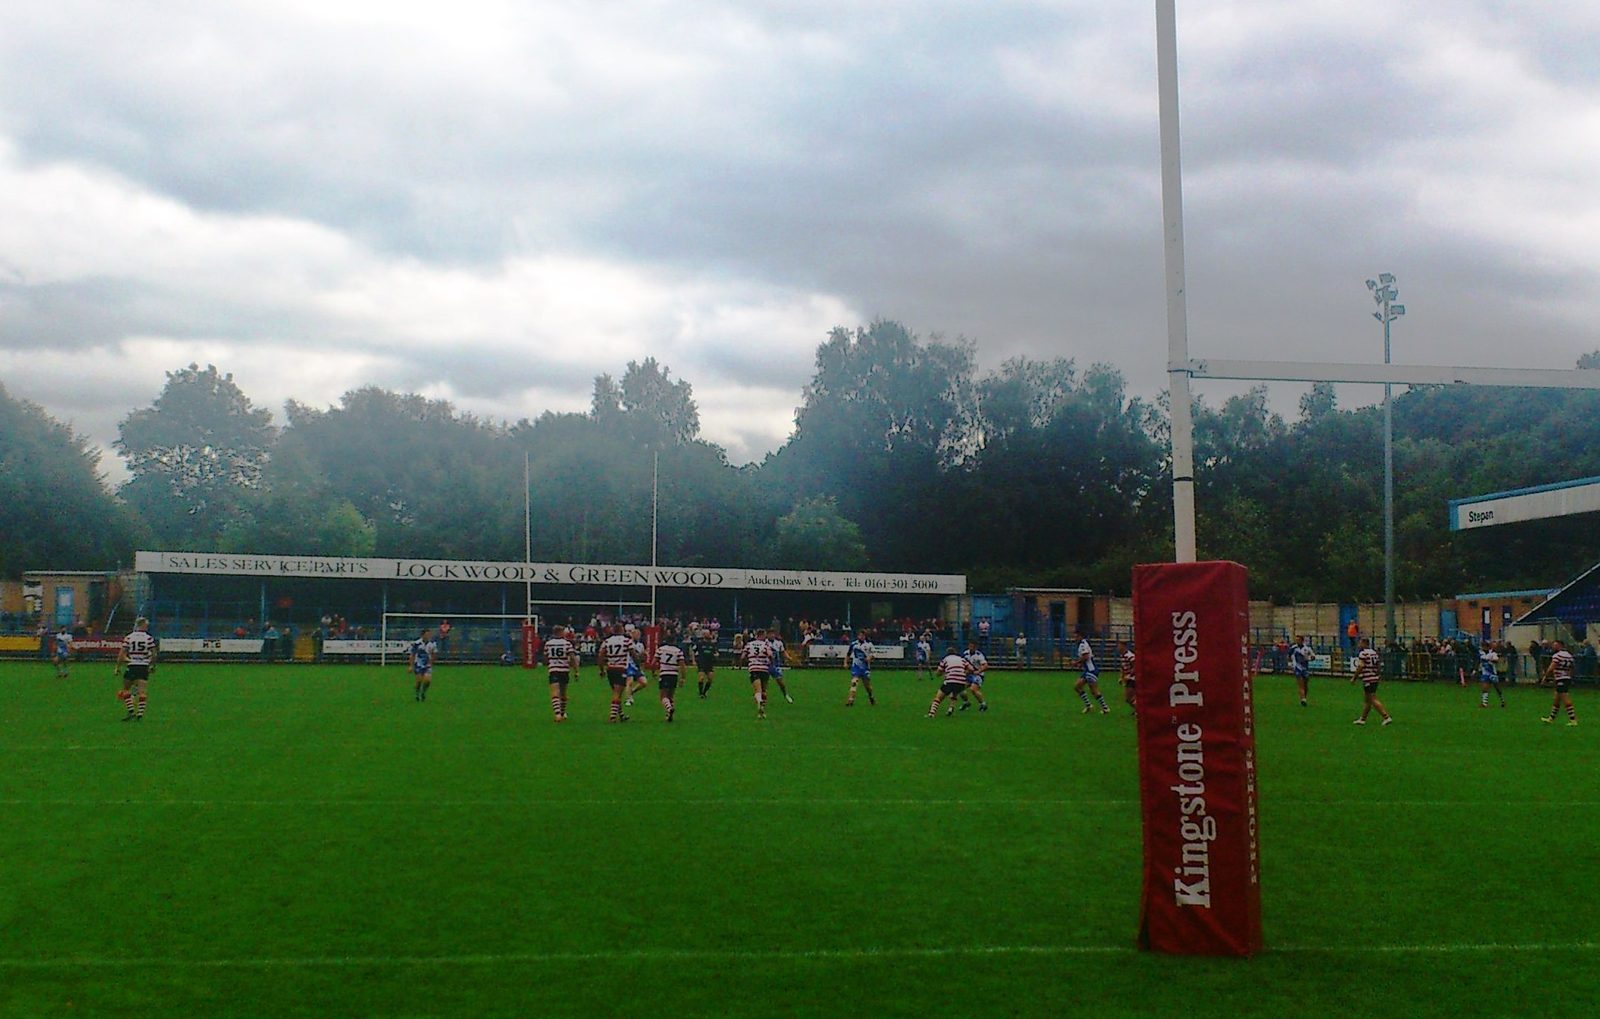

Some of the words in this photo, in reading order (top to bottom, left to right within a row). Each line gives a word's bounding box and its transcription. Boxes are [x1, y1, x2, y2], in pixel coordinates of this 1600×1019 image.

[1468, 511, 1494, 523] Stepan
[169, 556, 228, 570] SALES
[313, 560, 369, 574] PARTS
[396, 561, 536, 580] LOCKWOOD
[543, 568, 560, 582] &
[568, 566, 724, 586] GREENWOOD
[748, 574, 801, 586] Audenshaw
[911, 579, 939, 590] 5000
[131, 641, 146, 651] 15
[550, 646, 564, 657] 16
[608, 644, 622, 655] 17
[753, 646, 761, 656] 3
[665, 652, 674, 663] 7
[1169, 610, 1204, 708] Press
[1170, 723, 1217, 908] Kingstone
